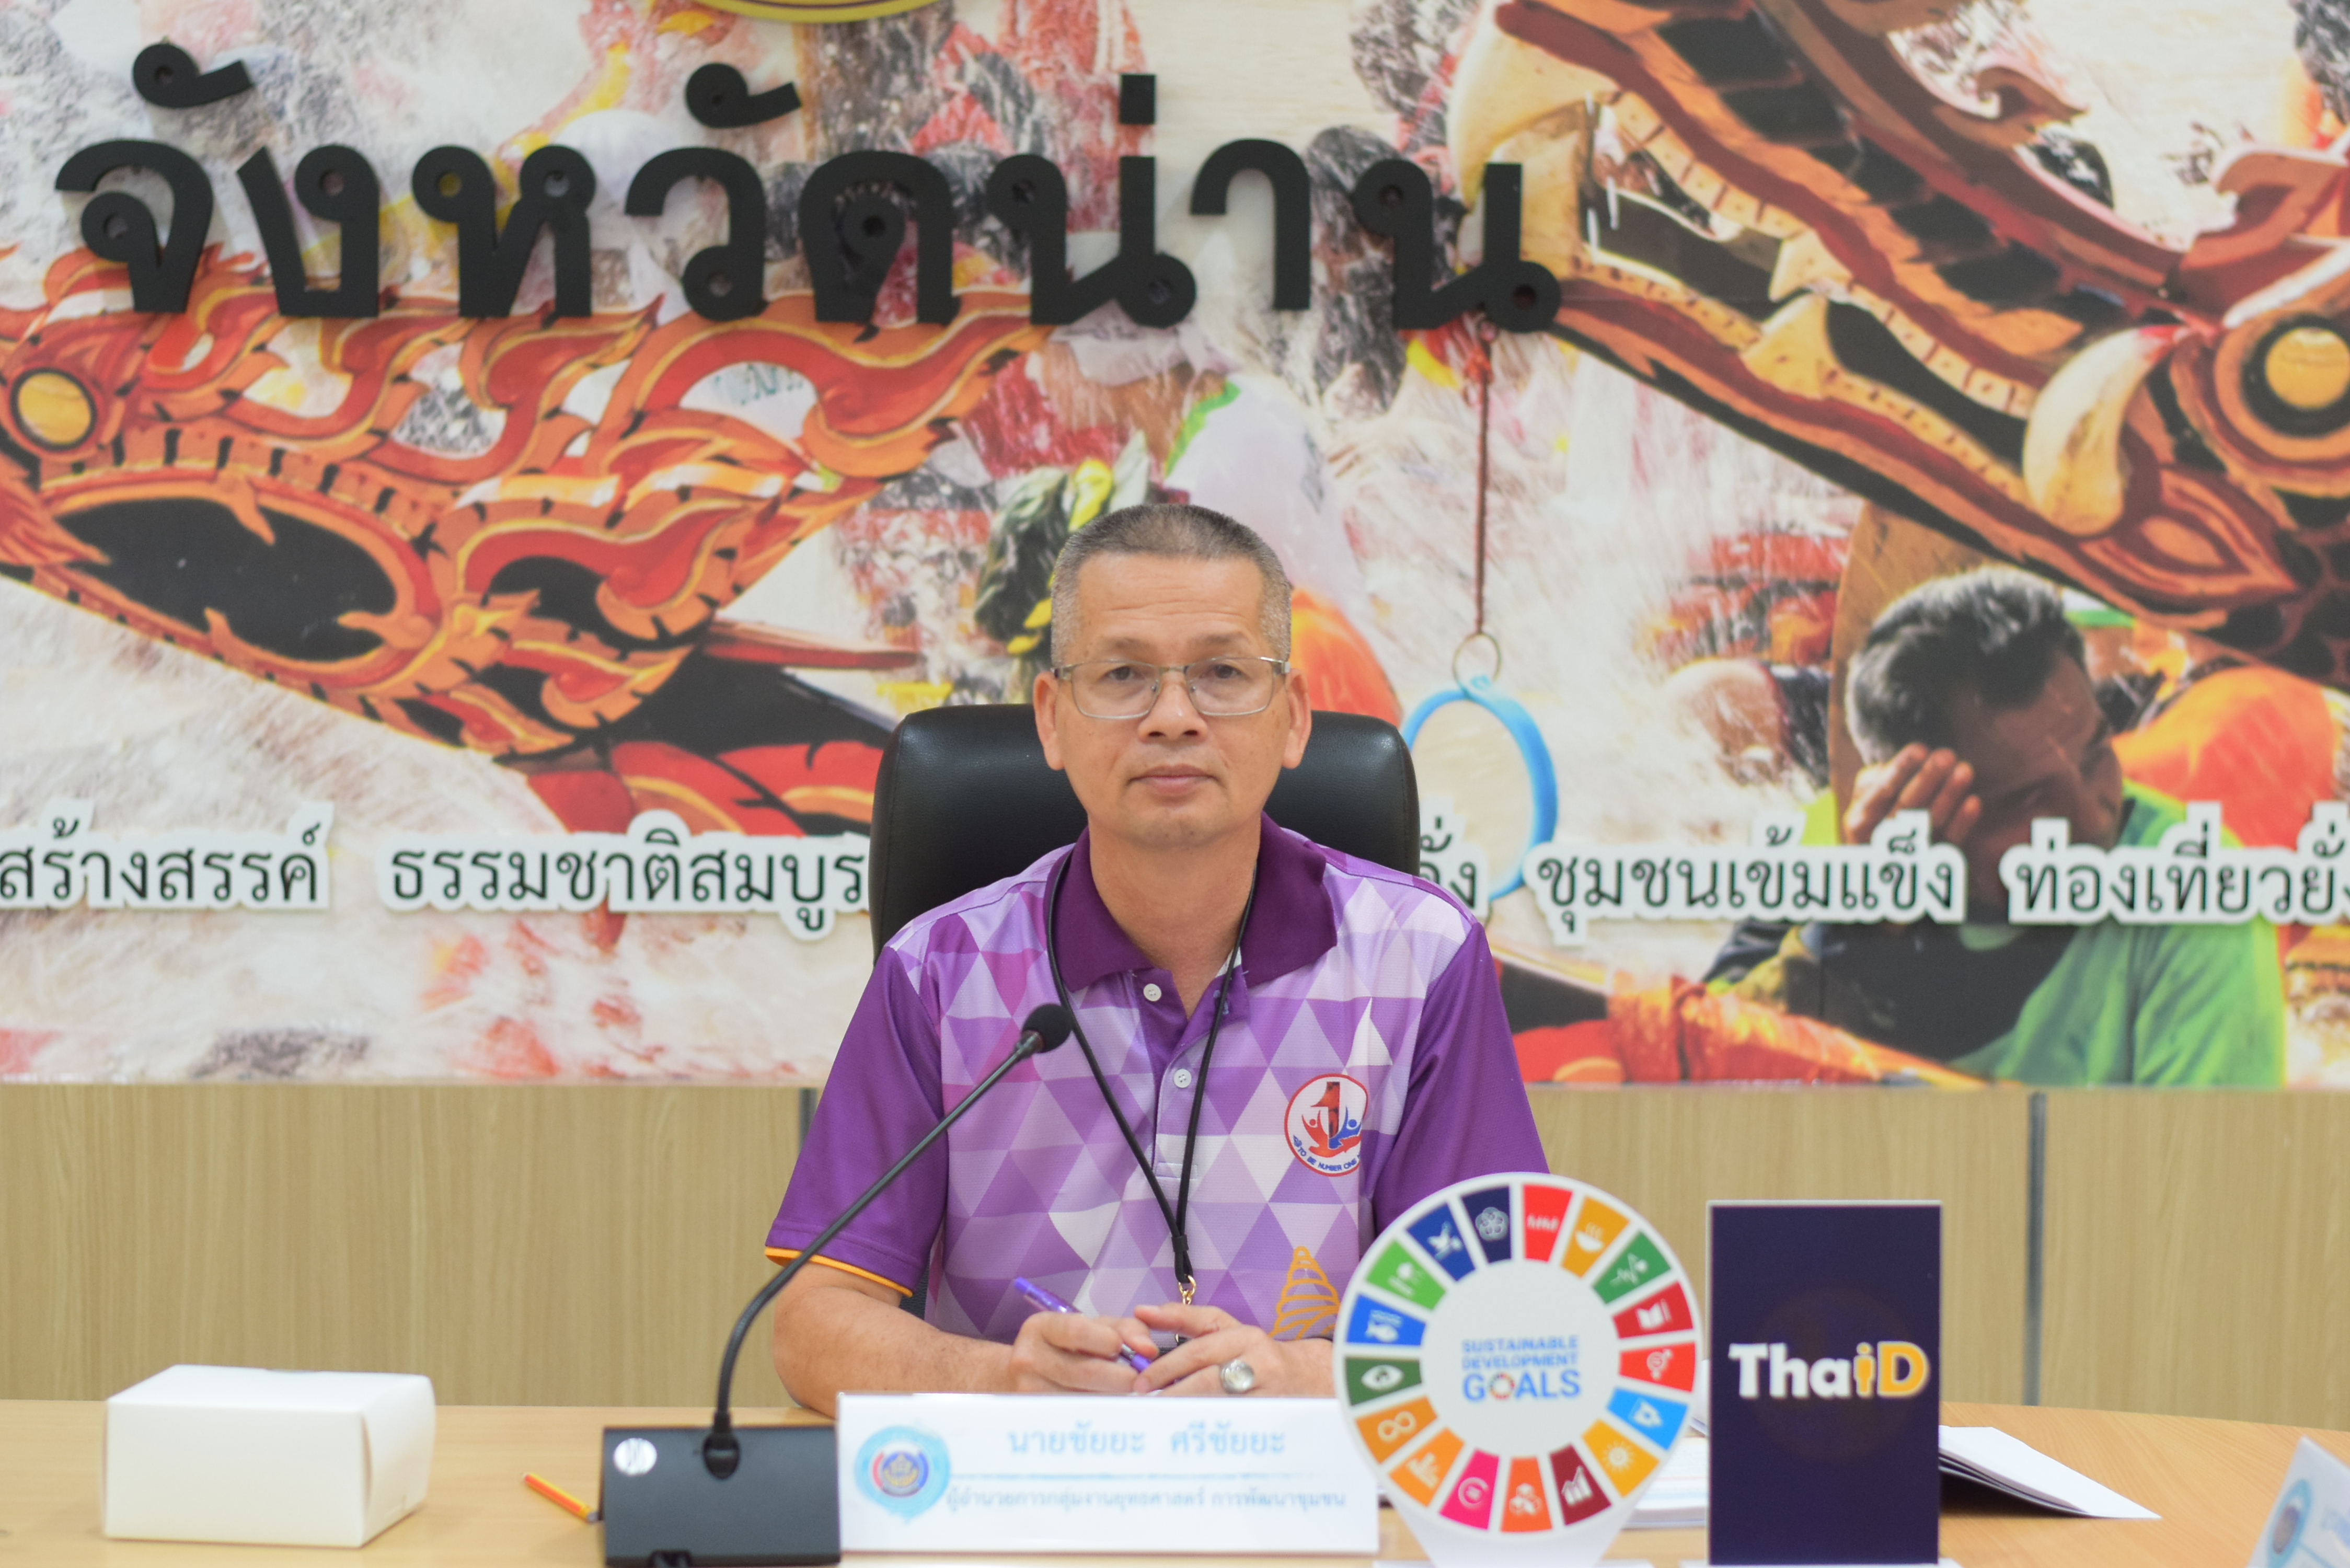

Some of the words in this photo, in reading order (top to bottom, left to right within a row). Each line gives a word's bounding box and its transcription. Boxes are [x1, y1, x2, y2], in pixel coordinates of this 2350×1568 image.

[55, 42, 1563, 333] จังหวัดน่าน
[0, 816, 321, 903] สร้างสรรค์
[389, 827, 867, 932] ธรรมชาติสมบูร
[1537, 825, 1953, 933] ชุมชนเข้มแข็ง
[2015, 820, 2350, 915] ท่องเที่ยวยั่
[1318, 1161, 1342, 1171] NUMBER
[1343, 1158, 1357, 1169] ONE
[1461, 1335, 1580, 1353] SUSTAINABLE
[1461, 1352, 1579, 1370] DEVELOPMENT
[1462, 1369, 1582, 1403] GOALS
[1728, 1340, 1931, 1399] ThaiD
